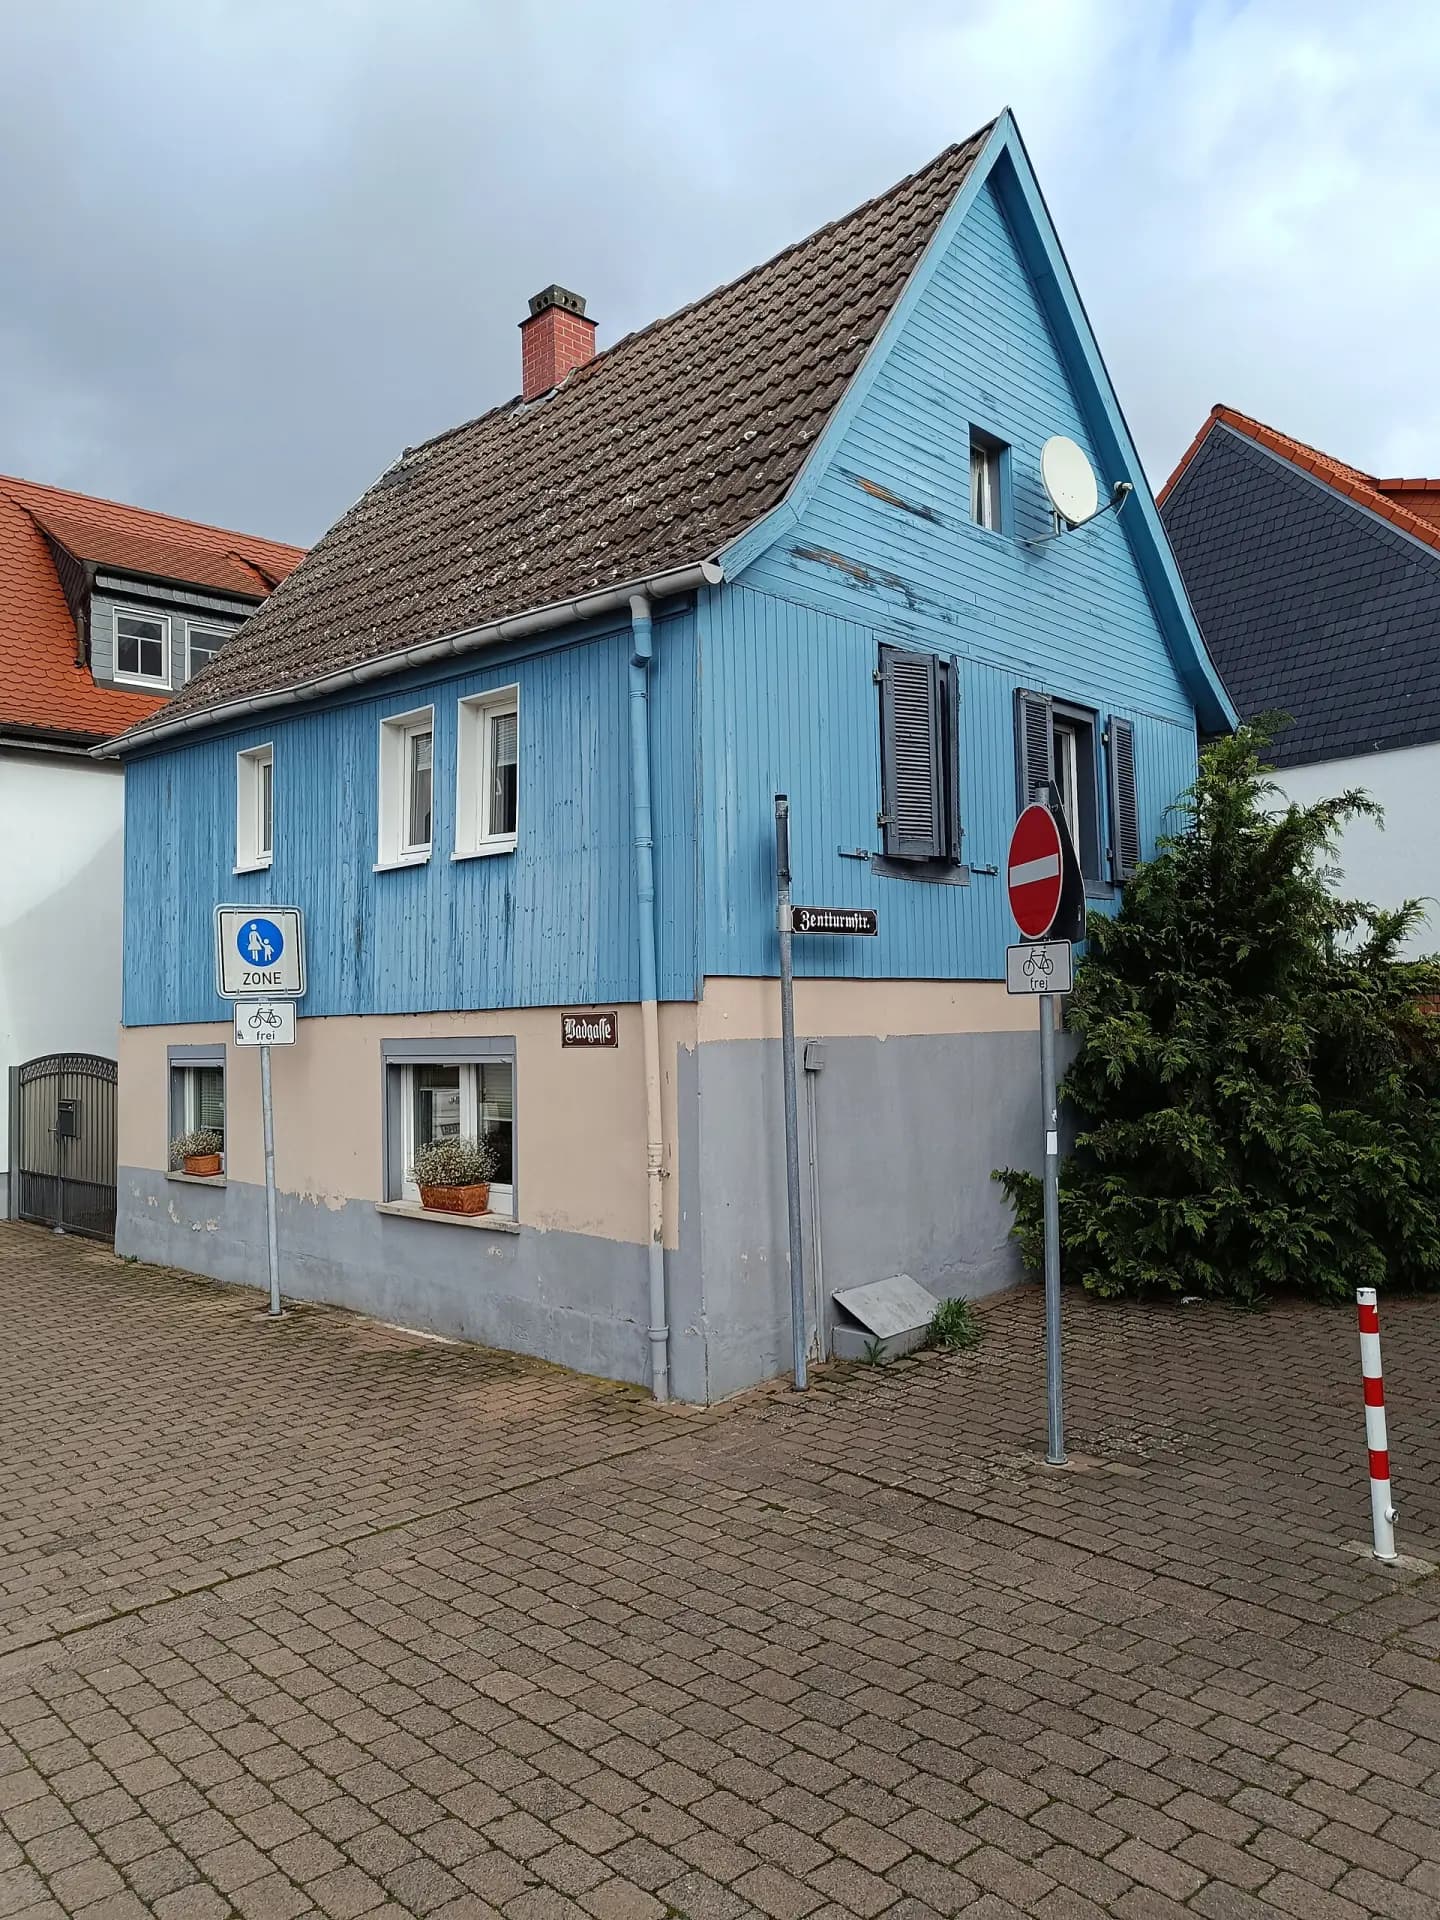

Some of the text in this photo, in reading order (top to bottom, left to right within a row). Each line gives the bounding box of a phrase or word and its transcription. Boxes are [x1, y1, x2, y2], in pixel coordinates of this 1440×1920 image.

[242, 971, 282, 985] ZONE
[1030, 976, 1048, 989] frei
[256, 1030, 275, 1041] frei
